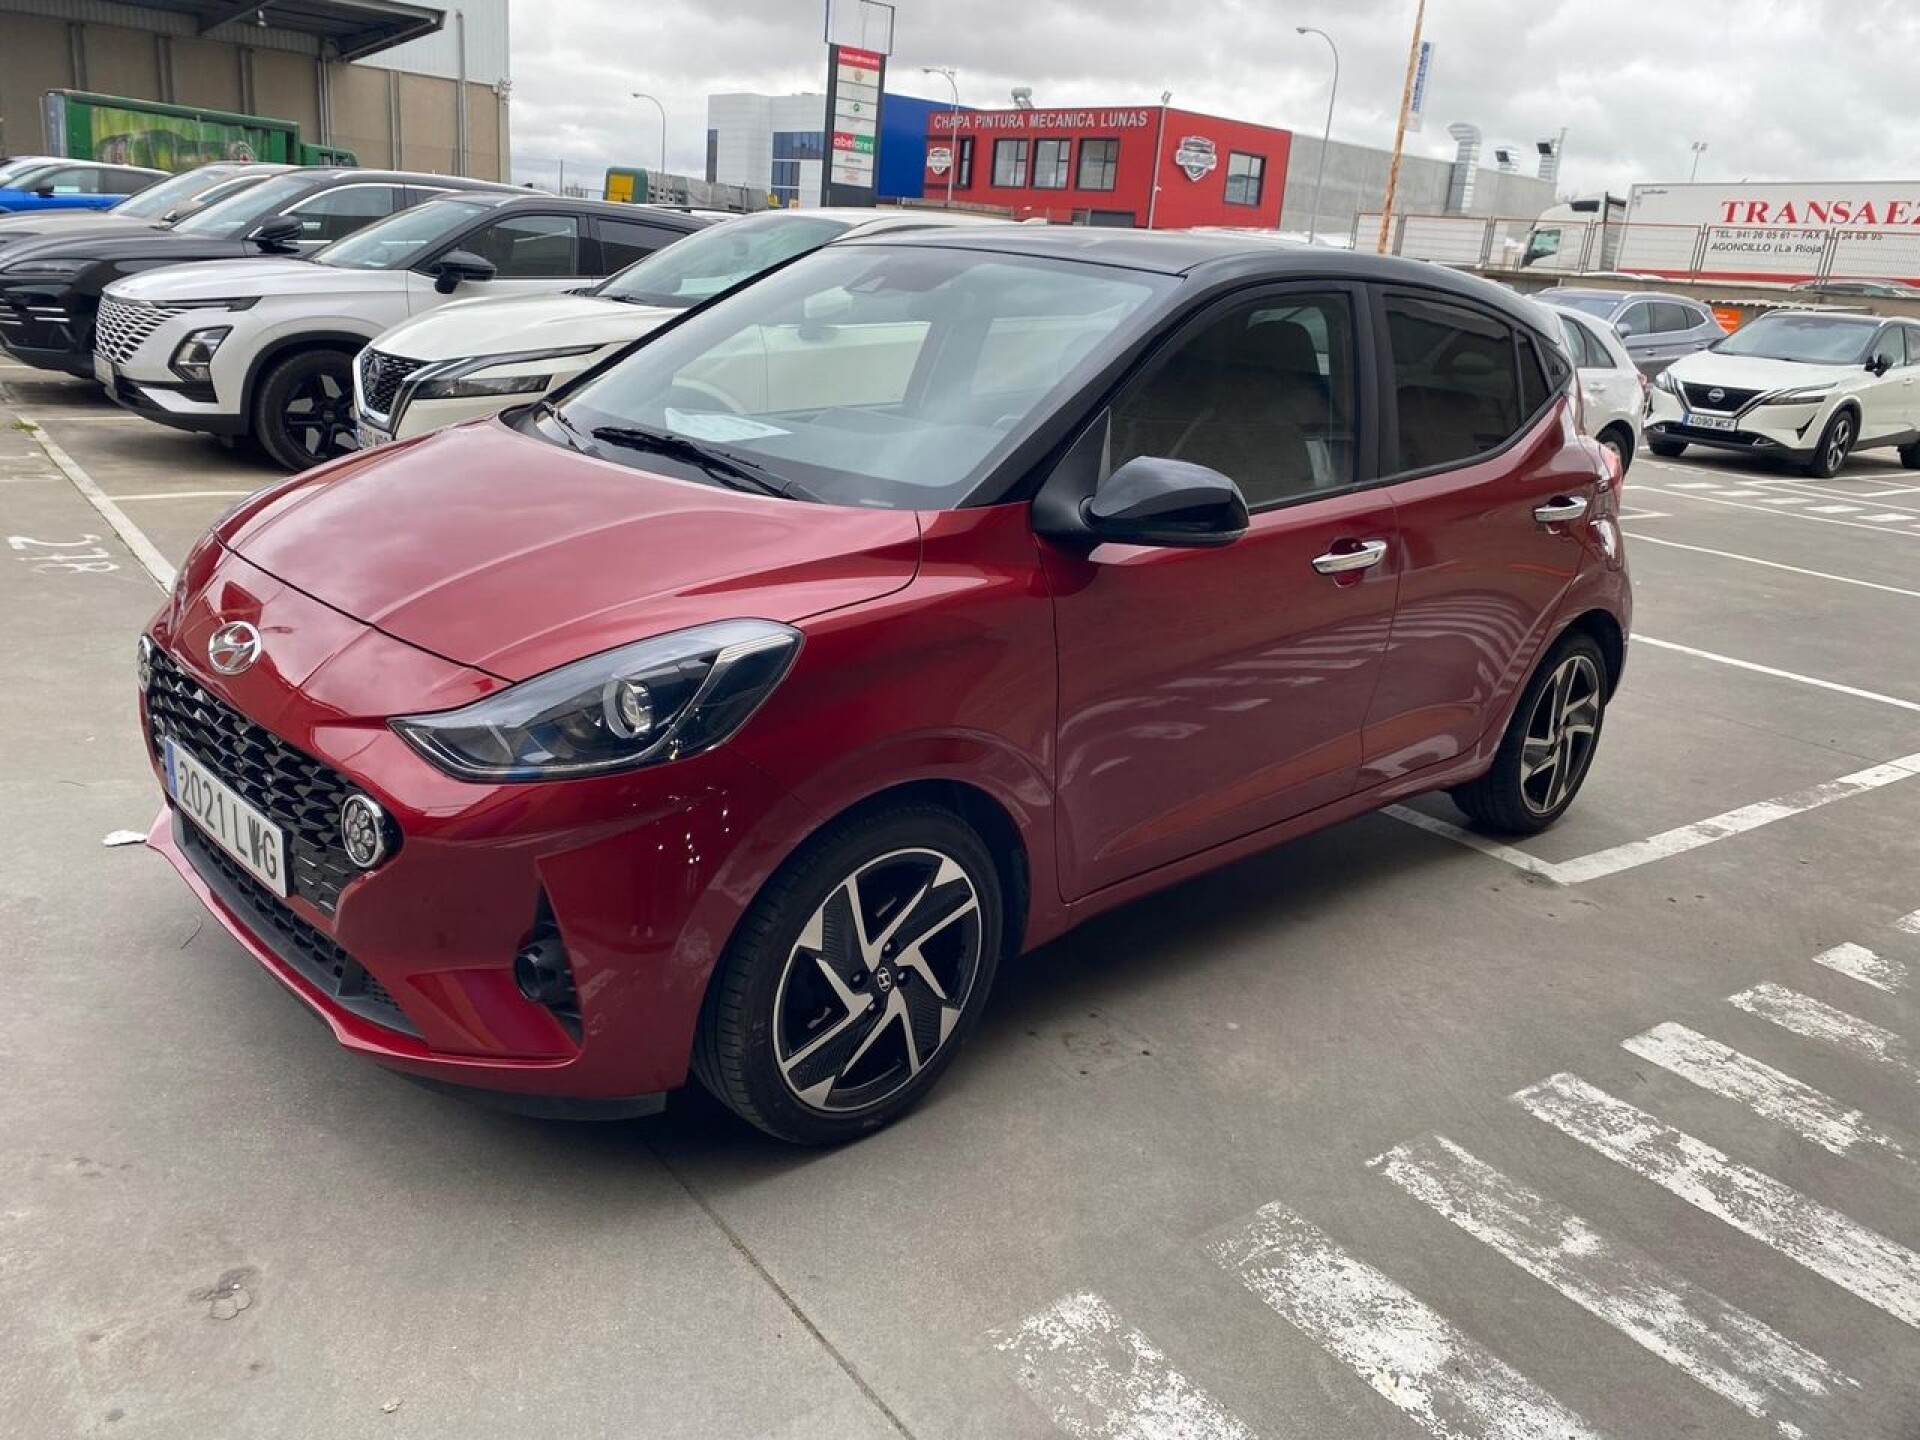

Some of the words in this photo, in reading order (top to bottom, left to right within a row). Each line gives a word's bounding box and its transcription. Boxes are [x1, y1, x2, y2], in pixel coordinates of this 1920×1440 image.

[934, 115, 970, 129] CHAPA
[975, 113, 1024, 128] PINTURA
[1029, 112, 1095, 127] MECANICA
[1100, 111, 1148, 127] LUNAS
[1711, 242, 1771, 252] AGONCILLO
[179, 761, 225, 839] 2021
[233, 803, 277, 880] LWG
